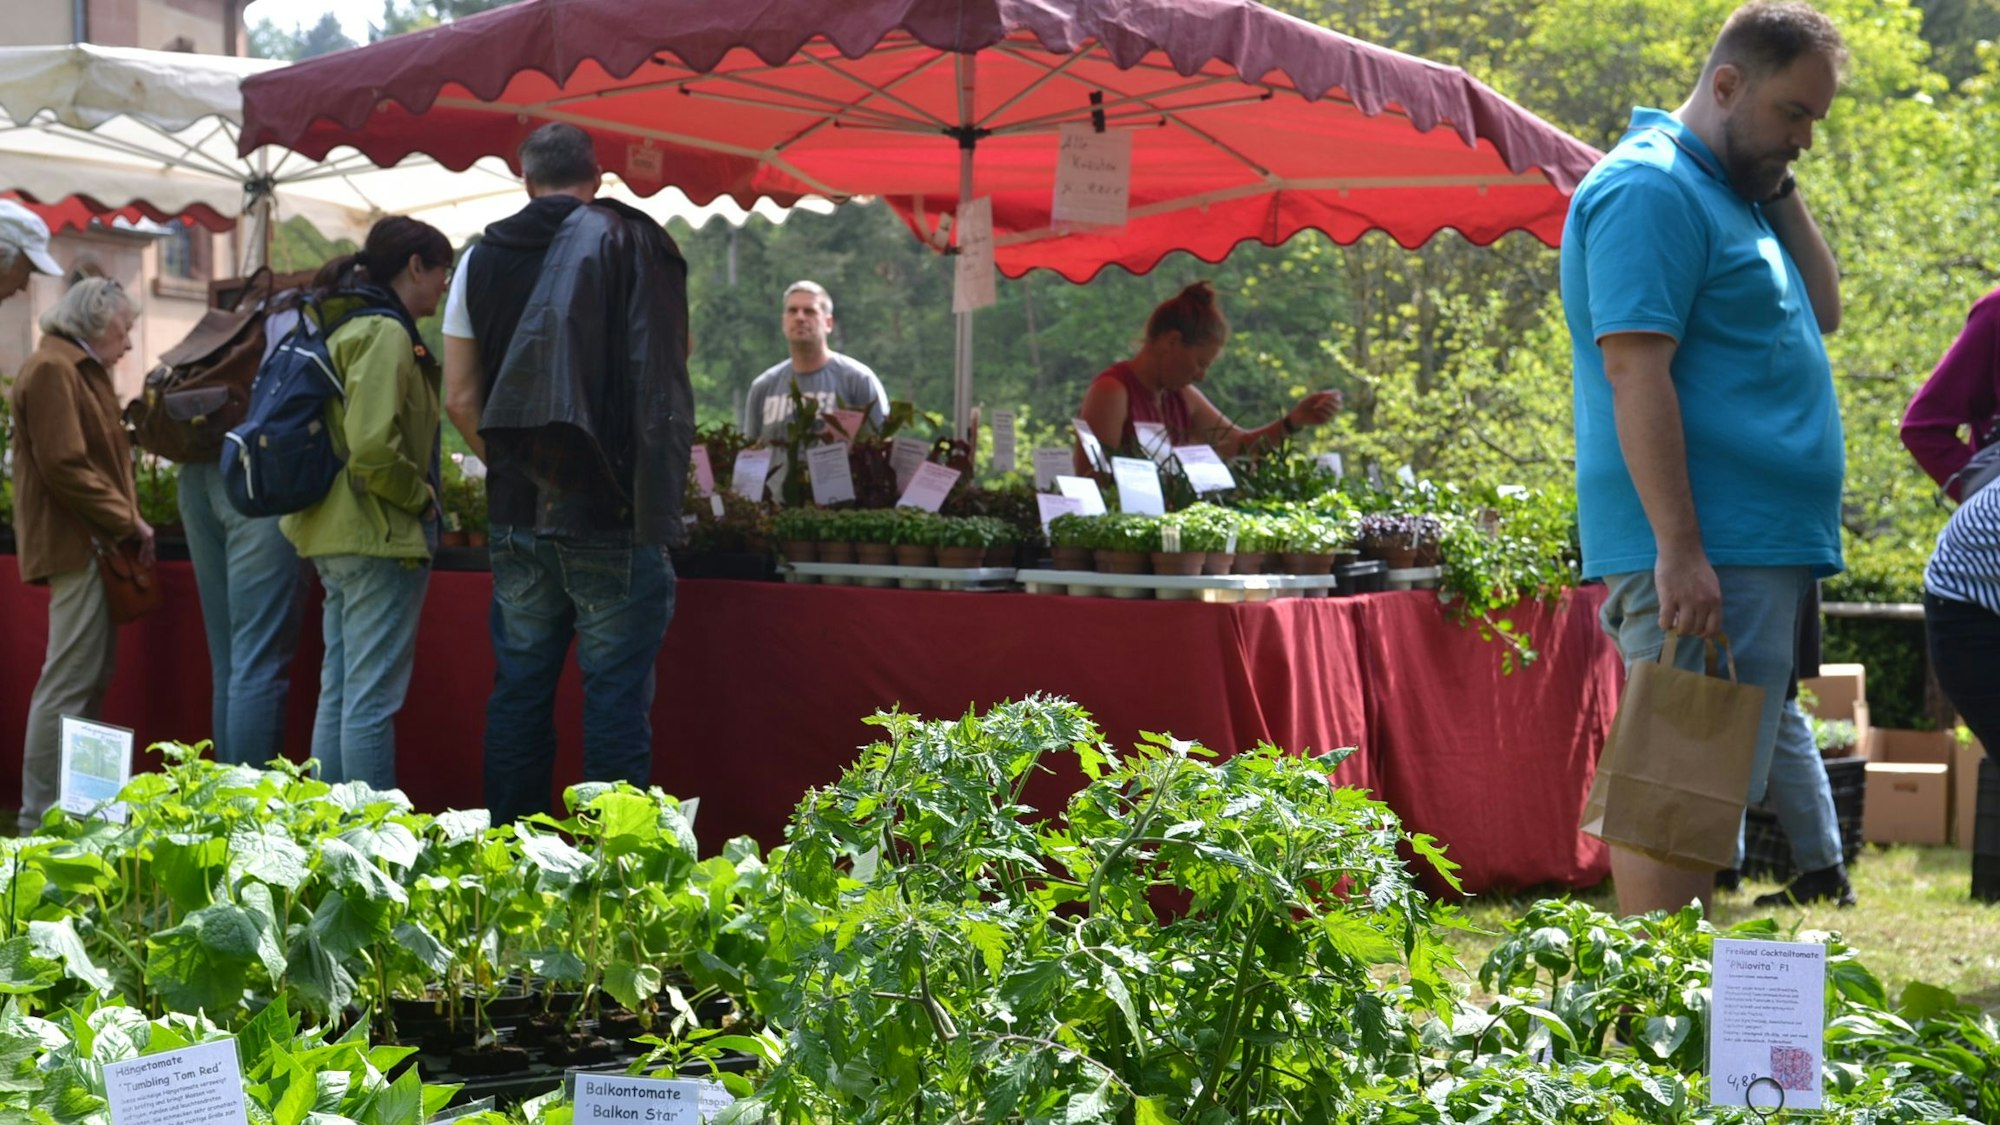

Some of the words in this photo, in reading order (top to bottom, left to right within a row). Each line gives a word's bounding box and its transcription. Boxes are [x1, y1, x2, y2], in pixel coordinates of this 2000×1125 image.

[1725, 946, 1757, 957] Freiland
[1760, 948, 1820, 960] Cocktailtomate
[1779, 963, 1790, 972] F1
[115, 1055, 183, 1078] Hängetomate
[173, 1070, 196, 1081] Tom
[585, 1081, 681, 1100] Balkontomate
